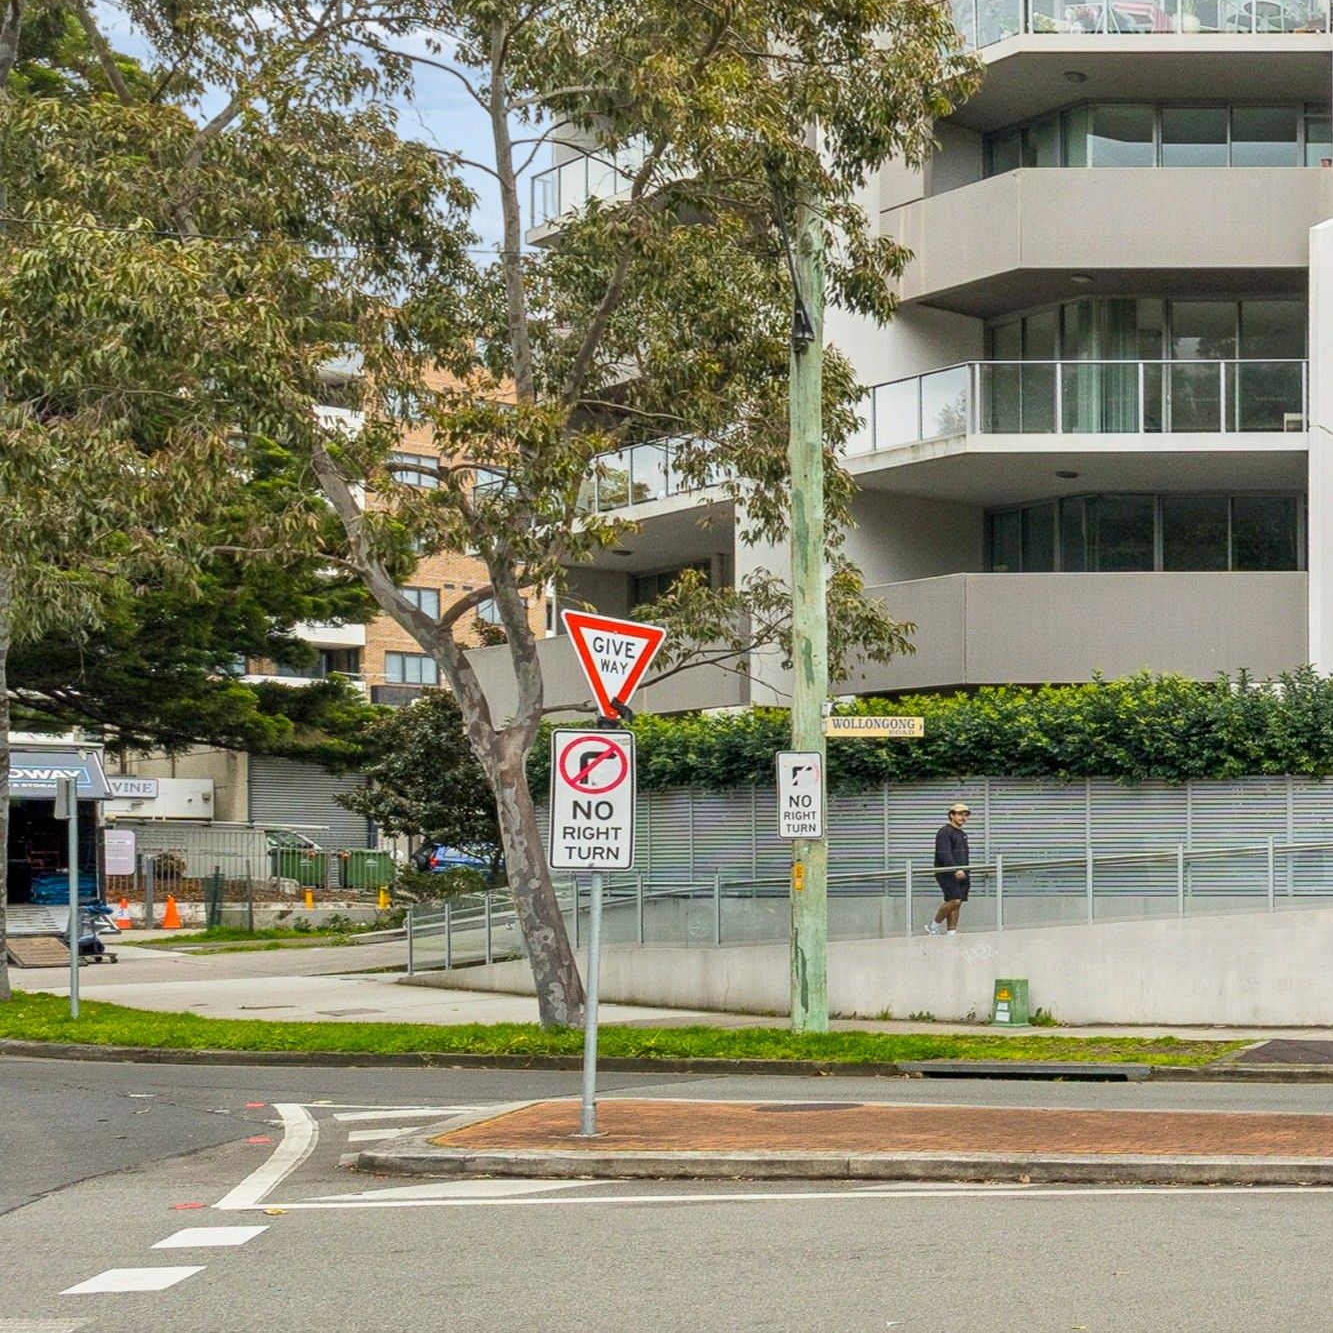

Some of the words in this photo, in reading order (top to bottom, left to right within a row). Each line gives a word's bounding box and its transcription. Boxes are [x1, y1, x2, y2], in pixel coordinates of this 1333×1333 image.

[593, 636, 636, 659] GIVE
[600, 658, 629, 675] WAY
[832, 718, 915, 729] WOLLONGONG
[789, 794, 812, 808] NO
[572, 800, 614, 821] NO
[783, 811, 817, 820] RIGHT
[562, 826, 622, 840] RIGHT
[786, 823, 817, 833] TURN
[564, 846, 620, 860] TURN
